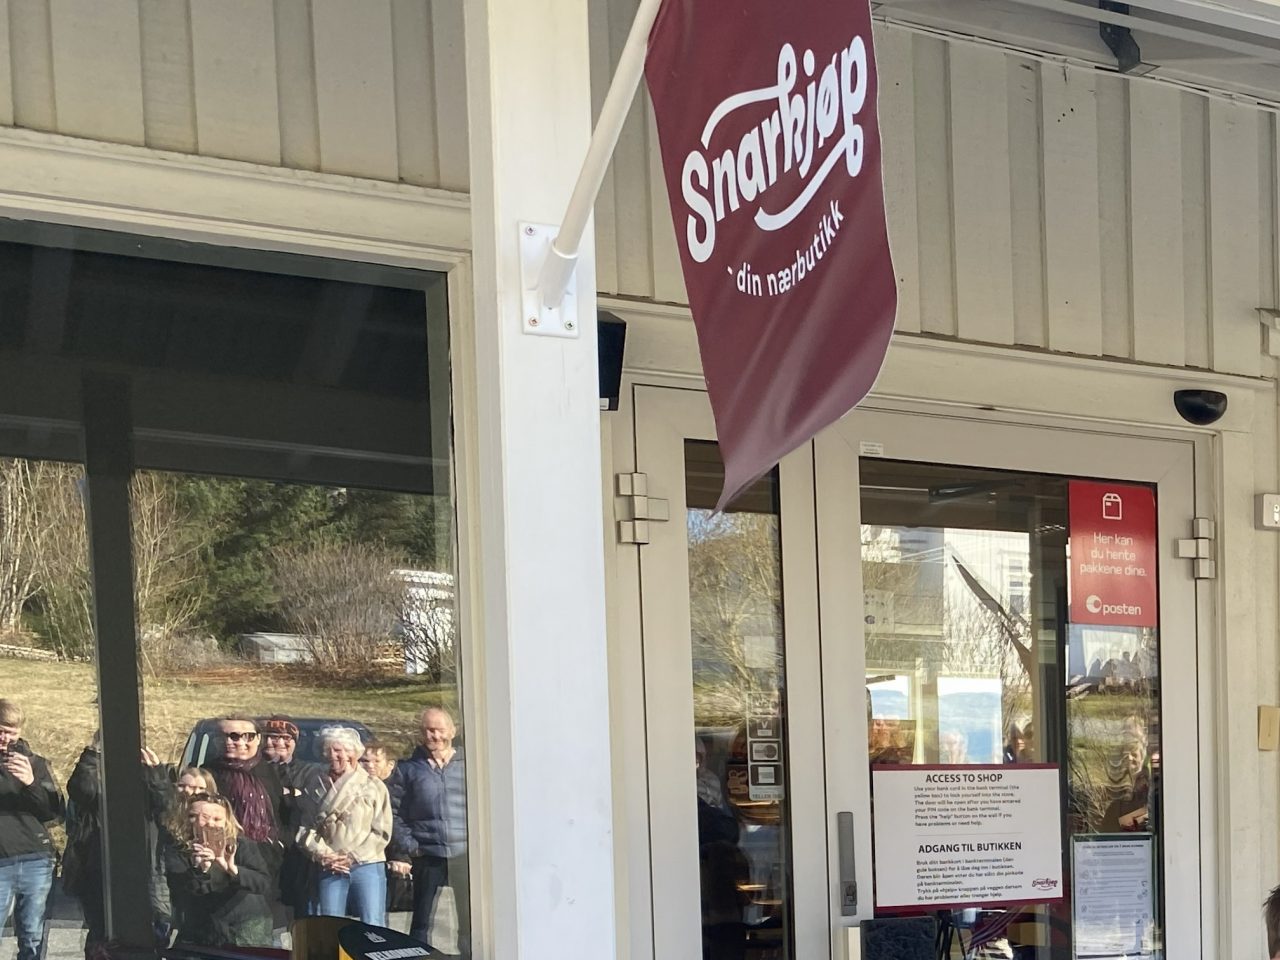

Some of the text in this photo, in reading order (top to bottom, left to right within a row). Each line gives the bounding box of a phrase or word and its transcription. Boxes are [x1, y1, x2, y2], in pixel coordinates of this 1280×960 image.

[681, 35, 868, 263] Snarkjøp
[736, 264, 763, 297] din
[767, 200, 845, 297] nærbutikk
[1093, 532, 1133, 546] Her kan
[1090, 547, 1136, 562] du hente
[1080, 563, 1147, 577] pakkene dine.
[1103, 602, 1142, 616] posten
[925, 773, 1003, 783] ACCESS TO SHOP
[918, 841, 1022, 854] ADGANG TIL BUTIKKEN
